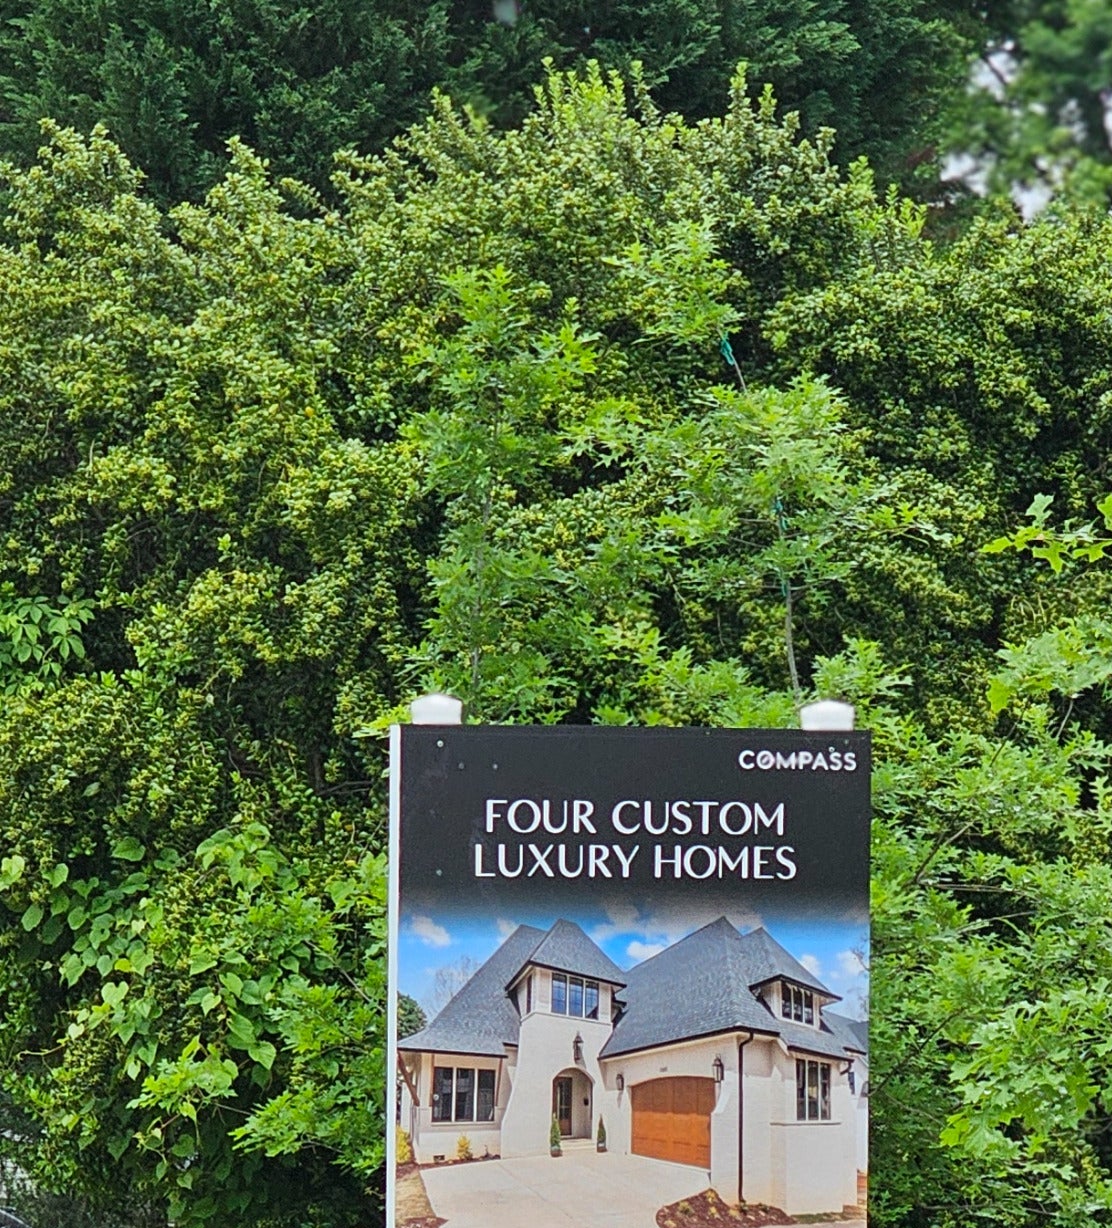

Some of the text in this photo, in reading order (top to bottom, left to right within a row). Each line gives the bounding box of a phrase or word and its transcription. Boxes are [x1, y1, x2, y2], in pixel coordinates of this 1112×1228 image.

[738, 749, 857, 772] COMPASS
[486, 799, 785, 836] FOUR CUSTOM
[474, 843, 797, 880] LUXURY HOMES
